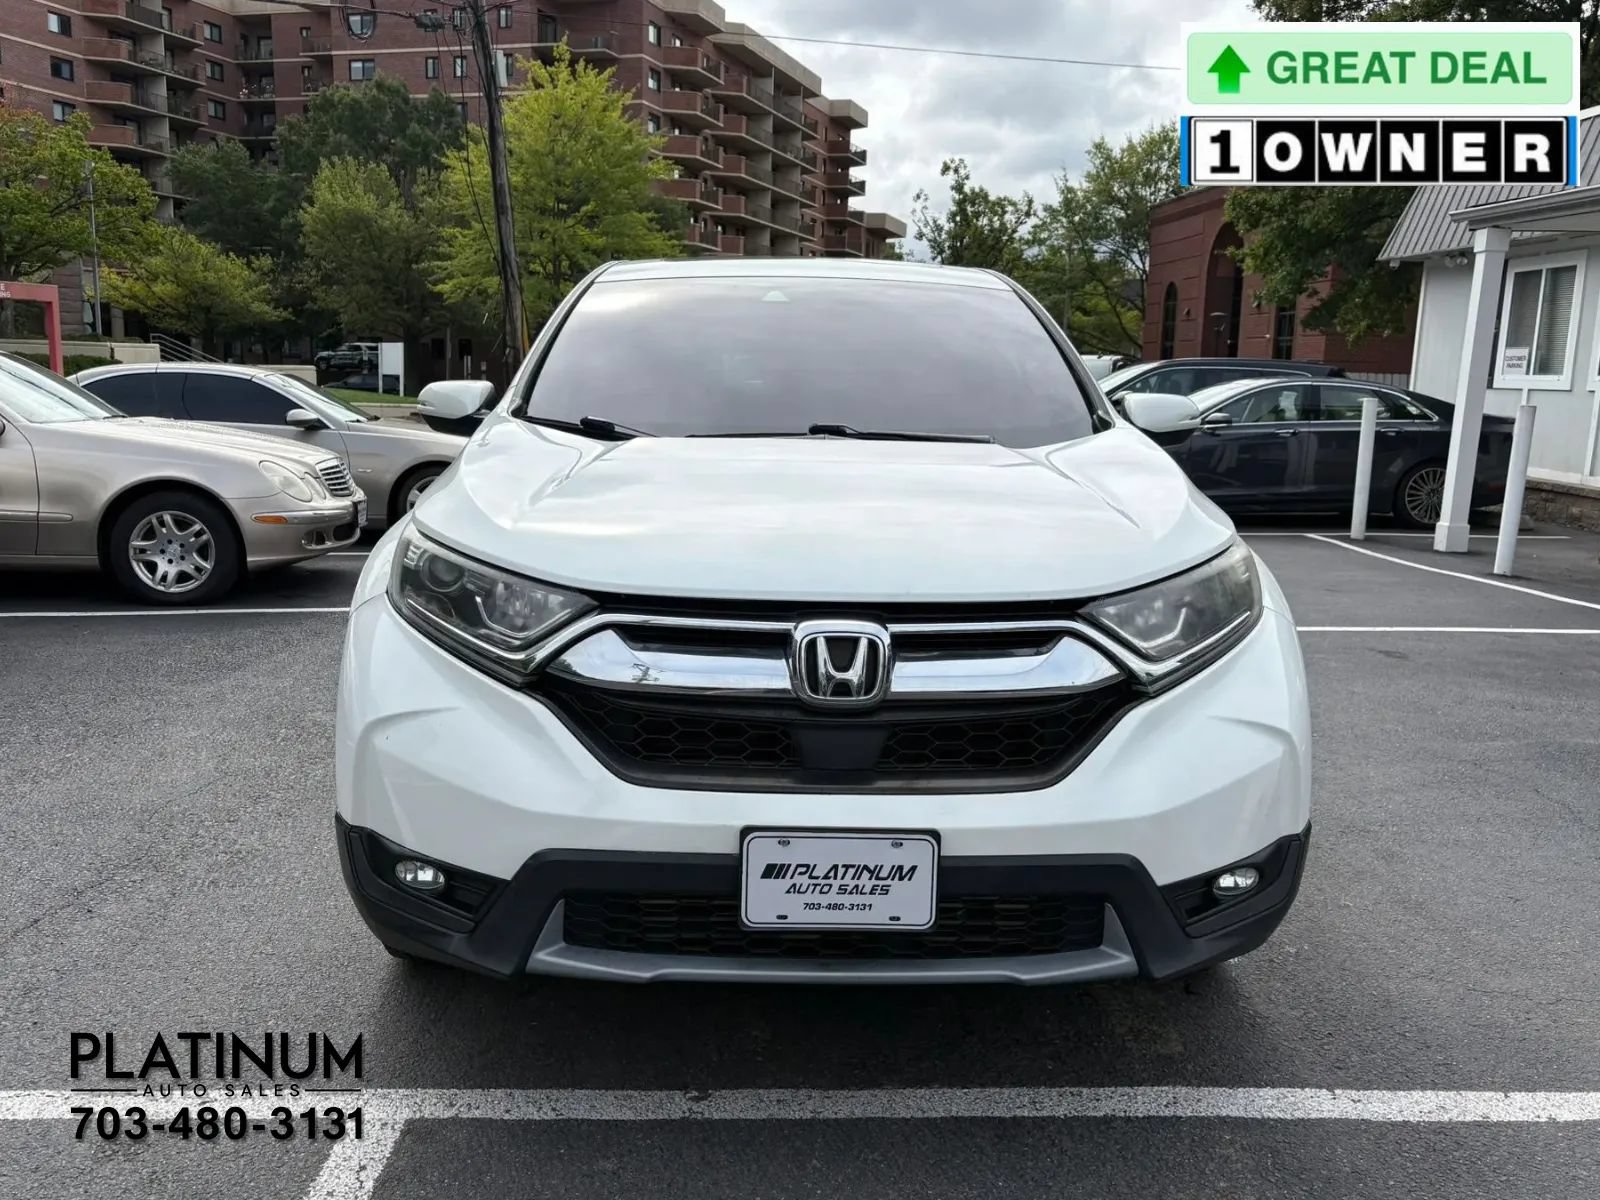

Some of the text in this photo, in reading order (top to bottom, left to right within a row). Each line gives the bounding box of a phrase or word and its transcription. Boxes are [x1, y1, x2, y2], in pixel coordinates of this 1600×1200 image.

[789, 863, 918, 881] PLATINUM
[785, 882, 892, 896] AUTO SALES
[802, 902, 873, 911] 703-480-3131
